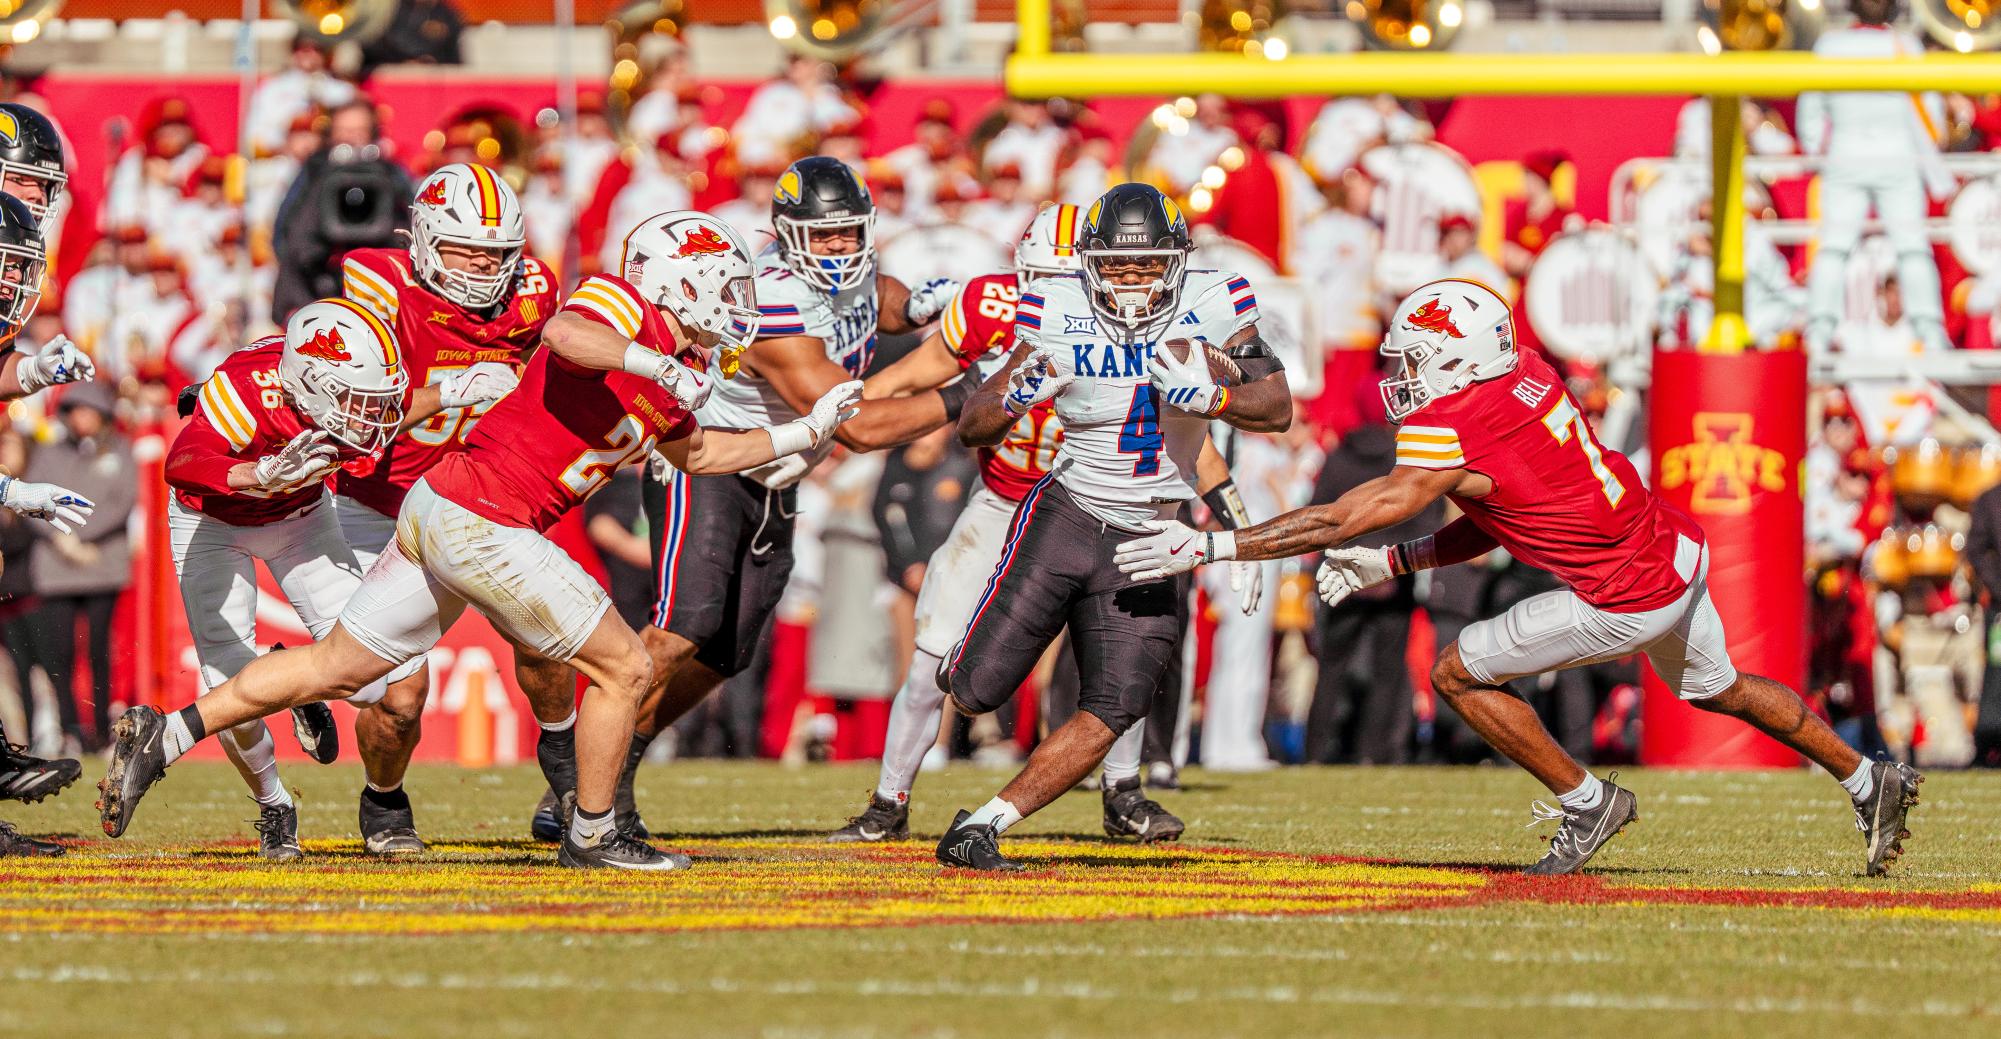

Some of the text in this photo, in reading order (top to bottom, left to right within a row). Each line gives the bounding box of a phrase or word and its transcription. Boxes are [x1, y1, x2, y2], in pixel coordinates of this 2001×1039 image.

[1116, 234, 1148, 243] KANSAS
[979, 281, 1018, 323] 26
[436, 350, 471, 361] IOWA
[251, 369, 283, 409] 36
[1512, 376, 1552, 409] BELL
[1117, 383, 1164, 478] 4
[1541, 391, 1626, 510] 7
[558, 413, 658, 497] 2
